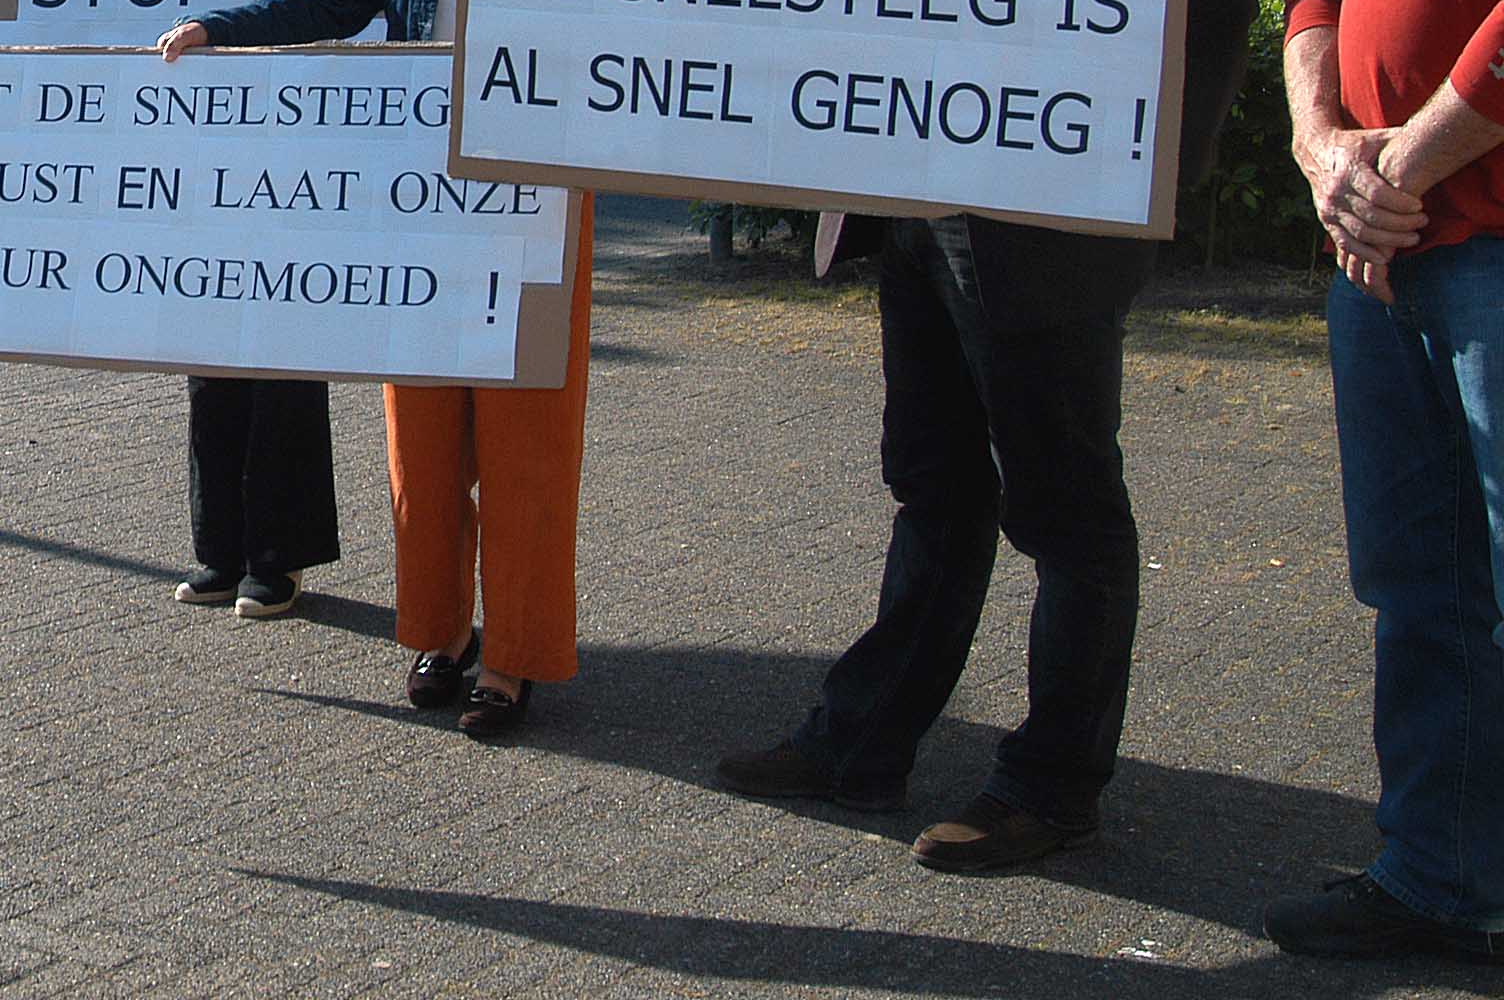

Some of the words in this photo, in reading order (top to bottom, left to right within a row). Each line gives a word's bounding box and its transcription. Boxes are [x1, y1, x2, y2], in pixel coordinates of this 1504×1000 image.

[35, 83, 106, 124] DE
[133, 85, 450, 128] SNELSTEEG
[479, 46, 559, 108] AL
[587, 53, 753, 124] SNEL
[791, 69, 1093, 156] GENOEG
[1131, 98, 1147, 161] !
[117, 166, 181, 211] EN
[211, 168, 361, 212] LAAT
[390, 171, 542, 215] ONZE
[95, 252, 439, 307] ONGEMOEID
[485, 271, 500, 325] !
